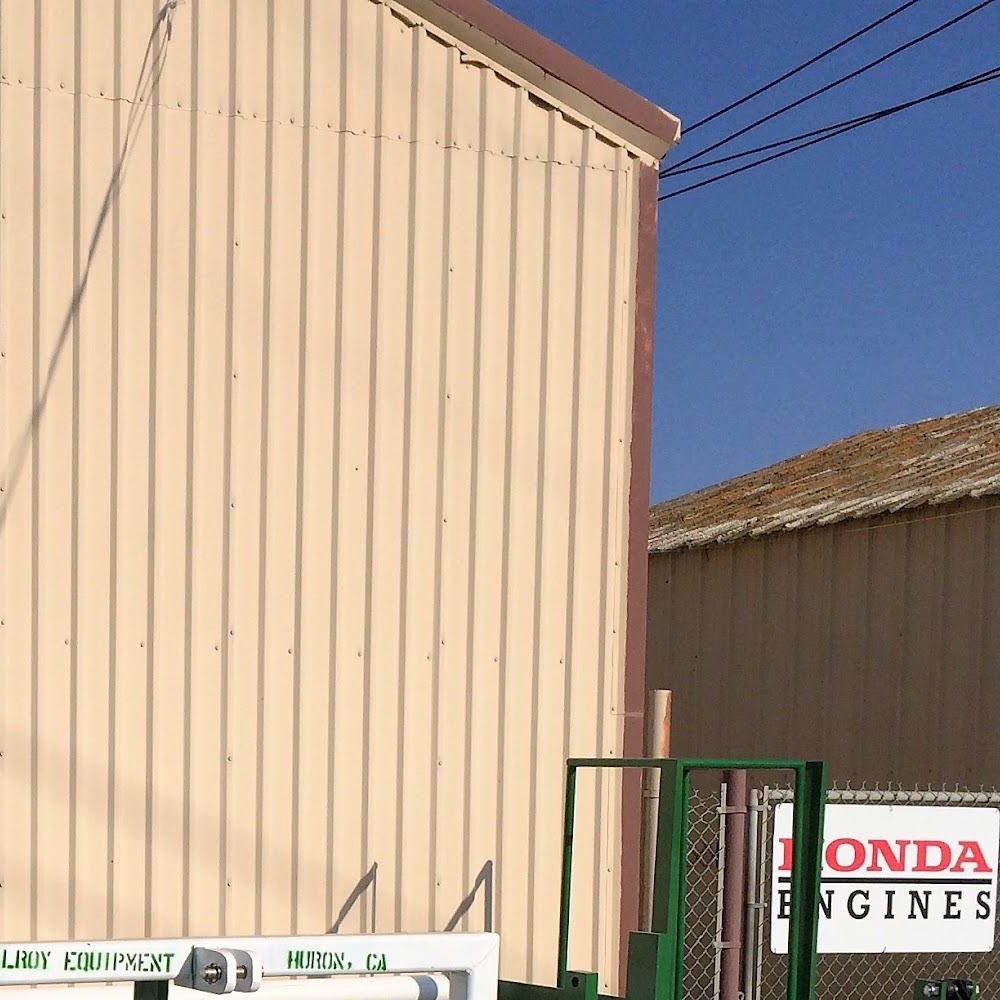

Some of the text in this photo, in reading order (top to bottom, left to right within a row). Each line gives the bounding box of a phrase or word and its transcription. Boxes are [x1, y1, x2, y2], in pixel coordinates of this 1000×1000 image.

[64, 951, 175, 972] EQUIPMENT
[287, 950, 352, 970] HURON,
[366, 953, 387, 971] CA
